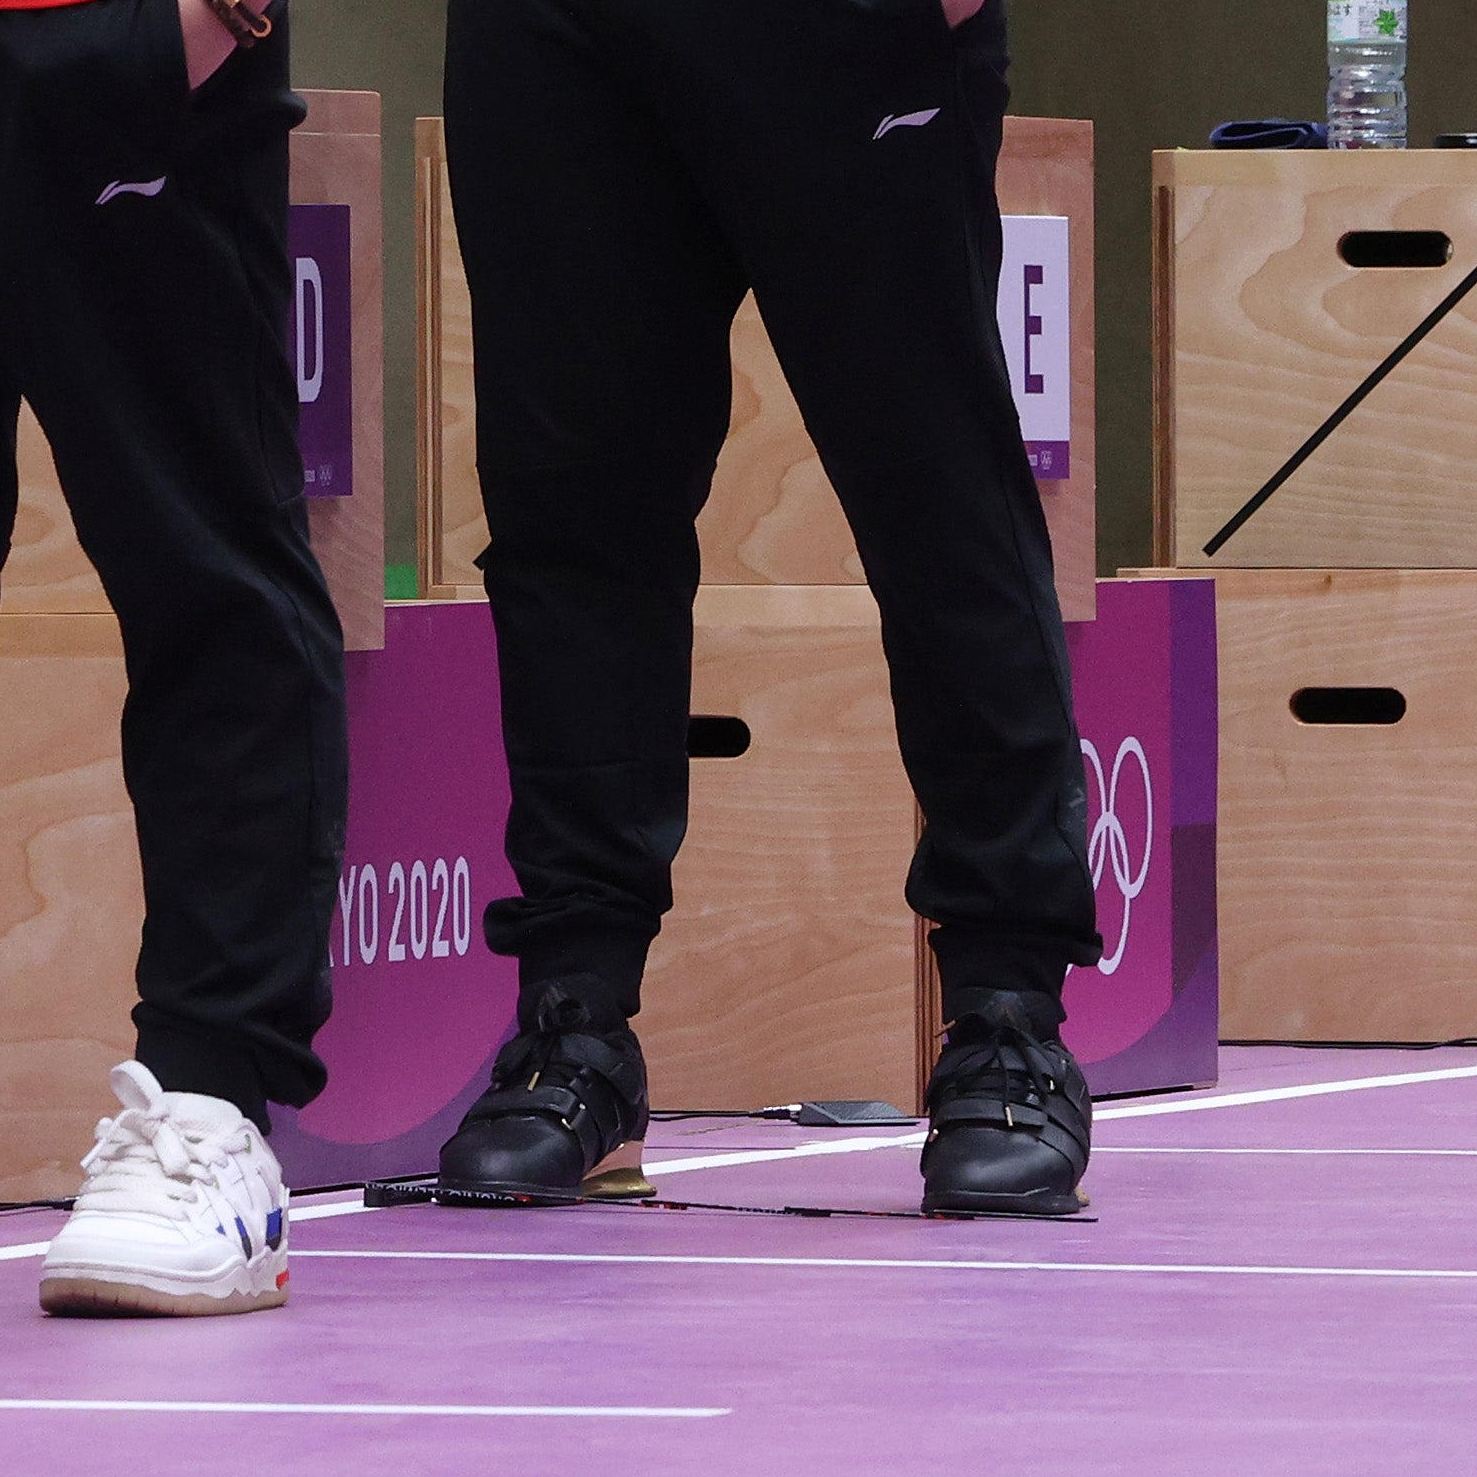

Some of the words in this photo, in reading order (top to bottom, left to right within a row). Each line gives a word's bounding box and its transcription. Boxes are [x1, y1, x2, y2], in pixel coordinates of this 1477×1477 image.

[295, 257, 323, 402] D
[1024, 265, 1044, 394] E
[329, 863, 378, 967] YO
[388, 856, 471, 961] 2020
